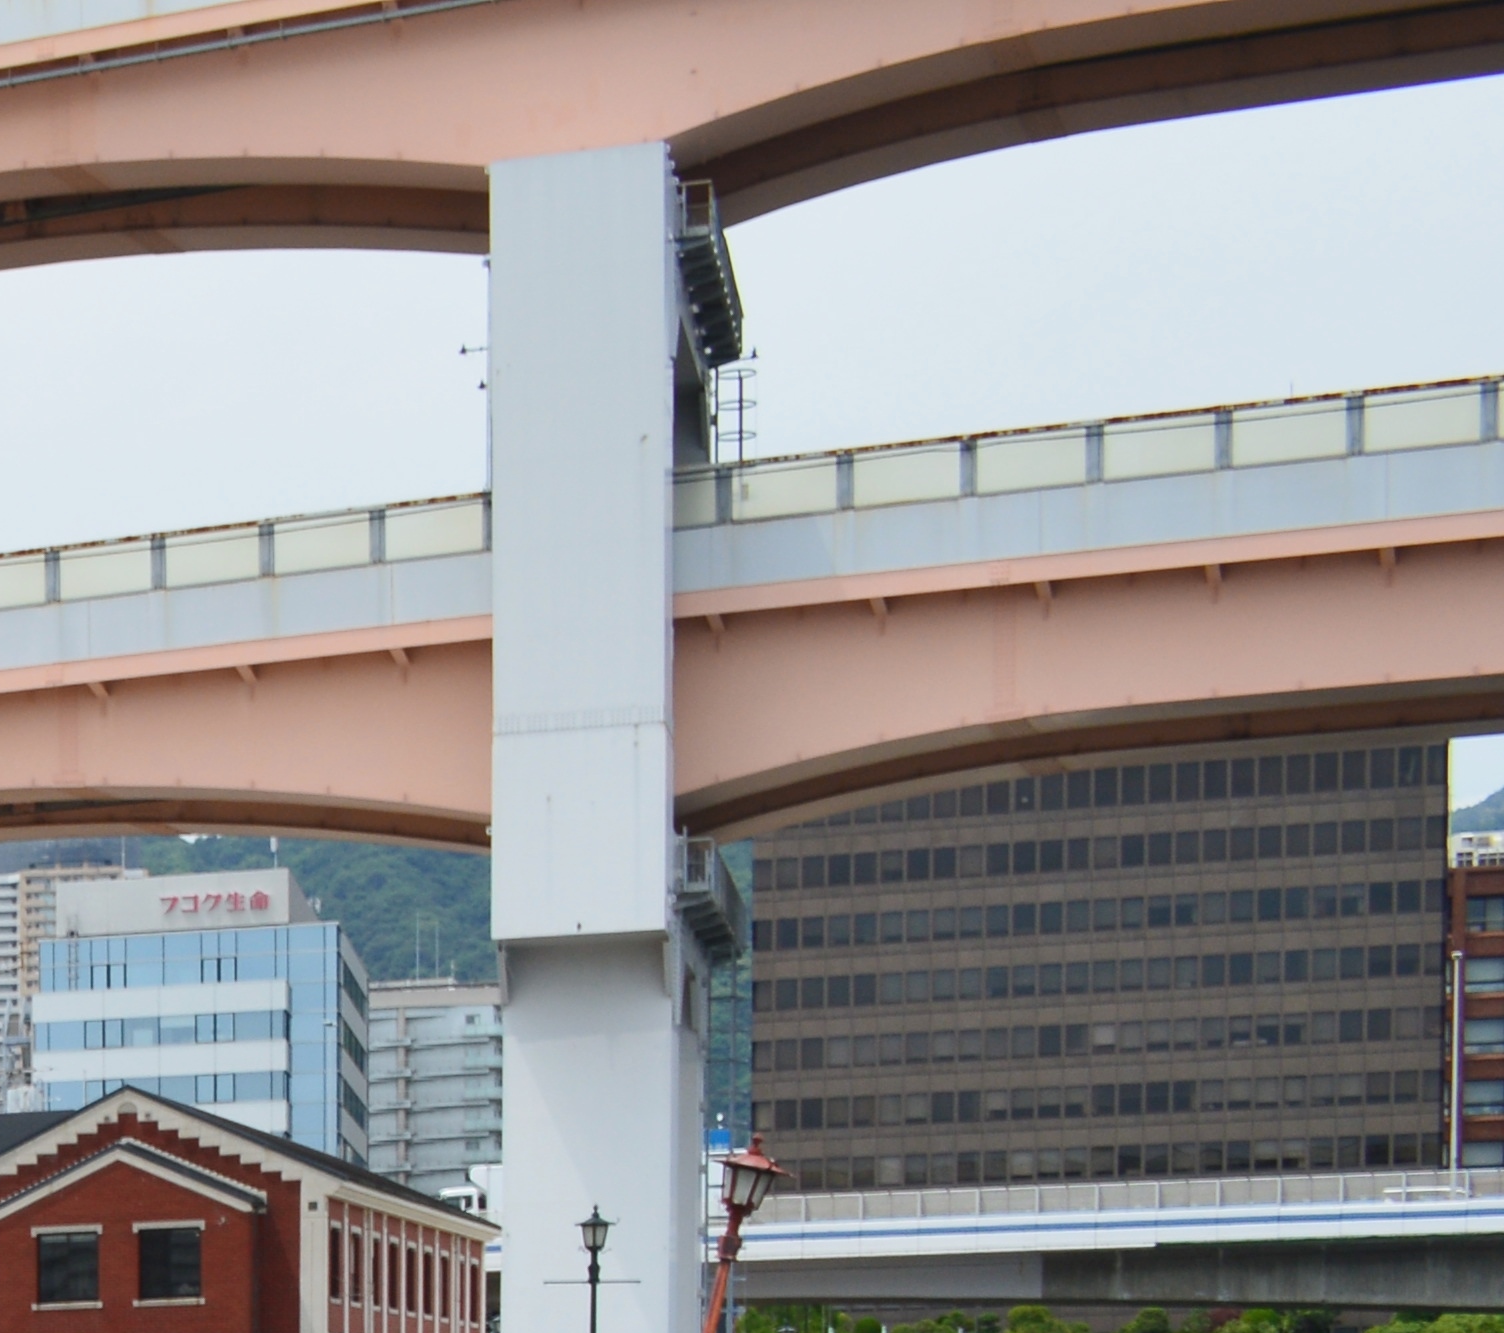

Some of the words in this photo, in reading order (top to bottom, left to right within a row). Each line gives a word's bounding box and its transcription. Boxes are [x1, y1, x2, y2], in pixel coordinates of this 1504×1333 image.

[159, 890, 270, 914] フコク生命
